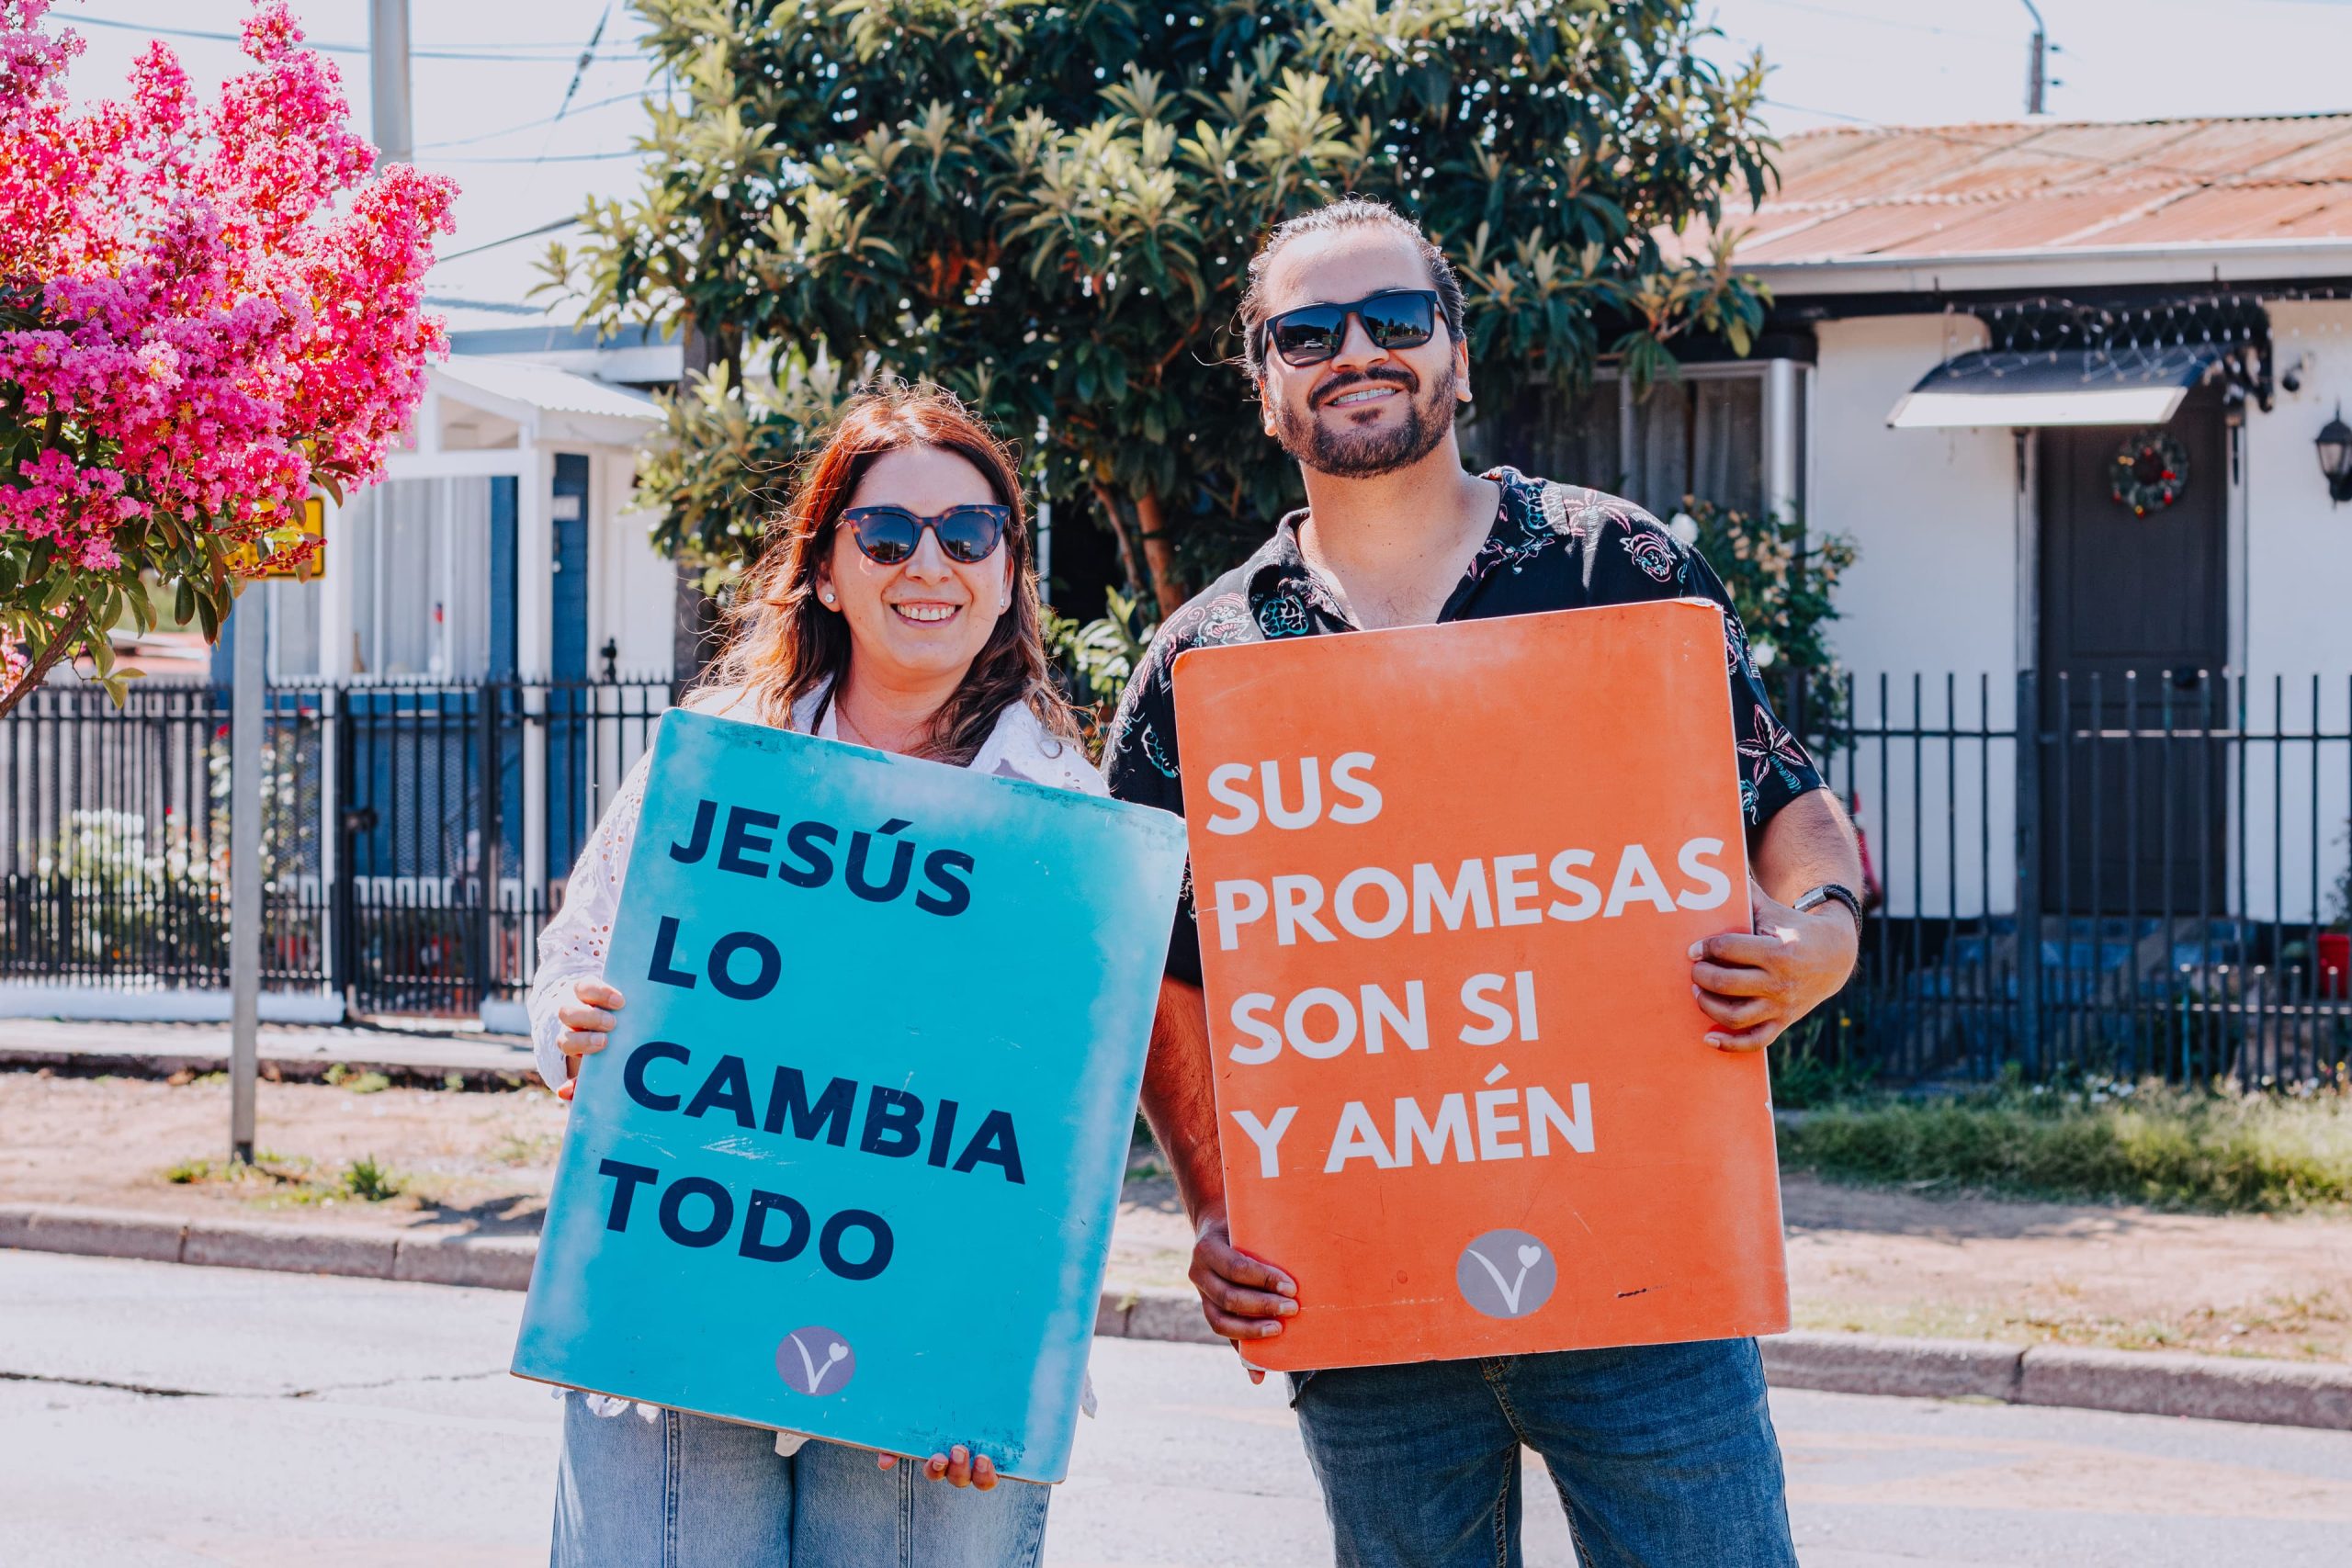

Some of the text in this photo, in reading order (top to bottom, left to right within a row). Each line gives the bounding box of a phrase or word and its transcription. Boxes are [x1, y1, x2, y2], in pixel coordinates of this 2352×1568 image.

[1205, 751, 1383, 836] SUS
[669, 799, 976, 917] JESÚS
[1211, 837, 1732, 951] PROMESAS
[647, 916, 782, 1001] LO
[1228, 971, 1539, 1066] SON SI
[623, 1042, 1026, 1185] CAMBIA
[1231, 1063, 1596, 1179] Y AMÉN
[598, 1158, 895, 1281] TODO
